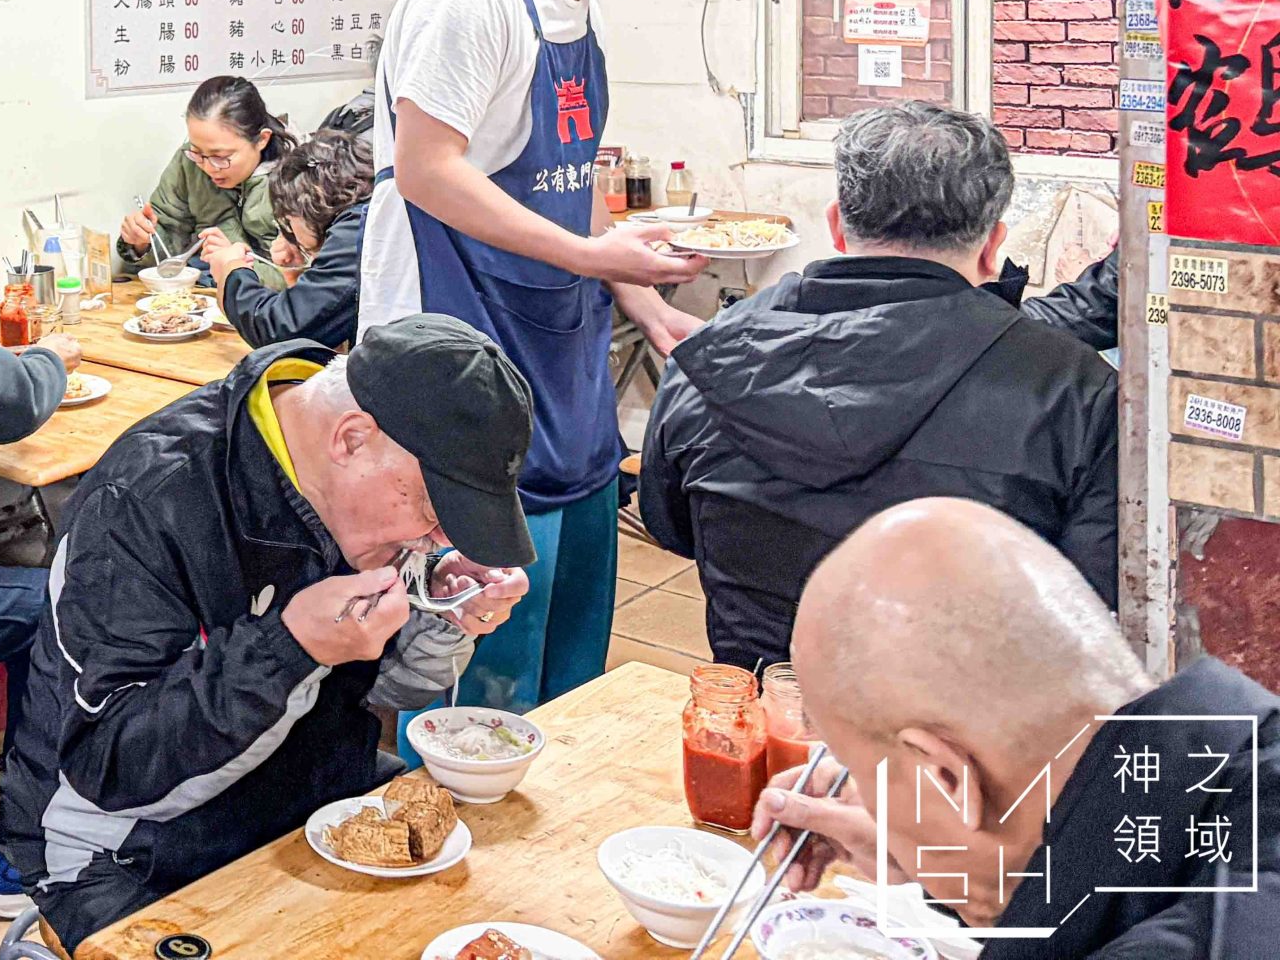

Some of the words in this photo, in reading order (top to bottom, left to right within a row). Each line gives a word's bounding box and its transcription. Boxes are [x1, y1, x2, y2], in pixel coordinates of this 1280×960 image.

[113, 22, 176, 44] 生腸
[184, 22, 199, 40] 60
[228, 18, 286, 38] 豬心
[292, 18, 305, 36] 60
[331, 13, 383, 32] 油豆腐
[113, 55, 176, 77] 粉腸
[184, 54, 199, 72] 60
[228, 49, 286, 70] 豬小肚
[292, 48, 305, 66] 60
[1171, 270, 1226, 292] 2396-5073
[1187, 405, 1242, 433] 2936-8008
